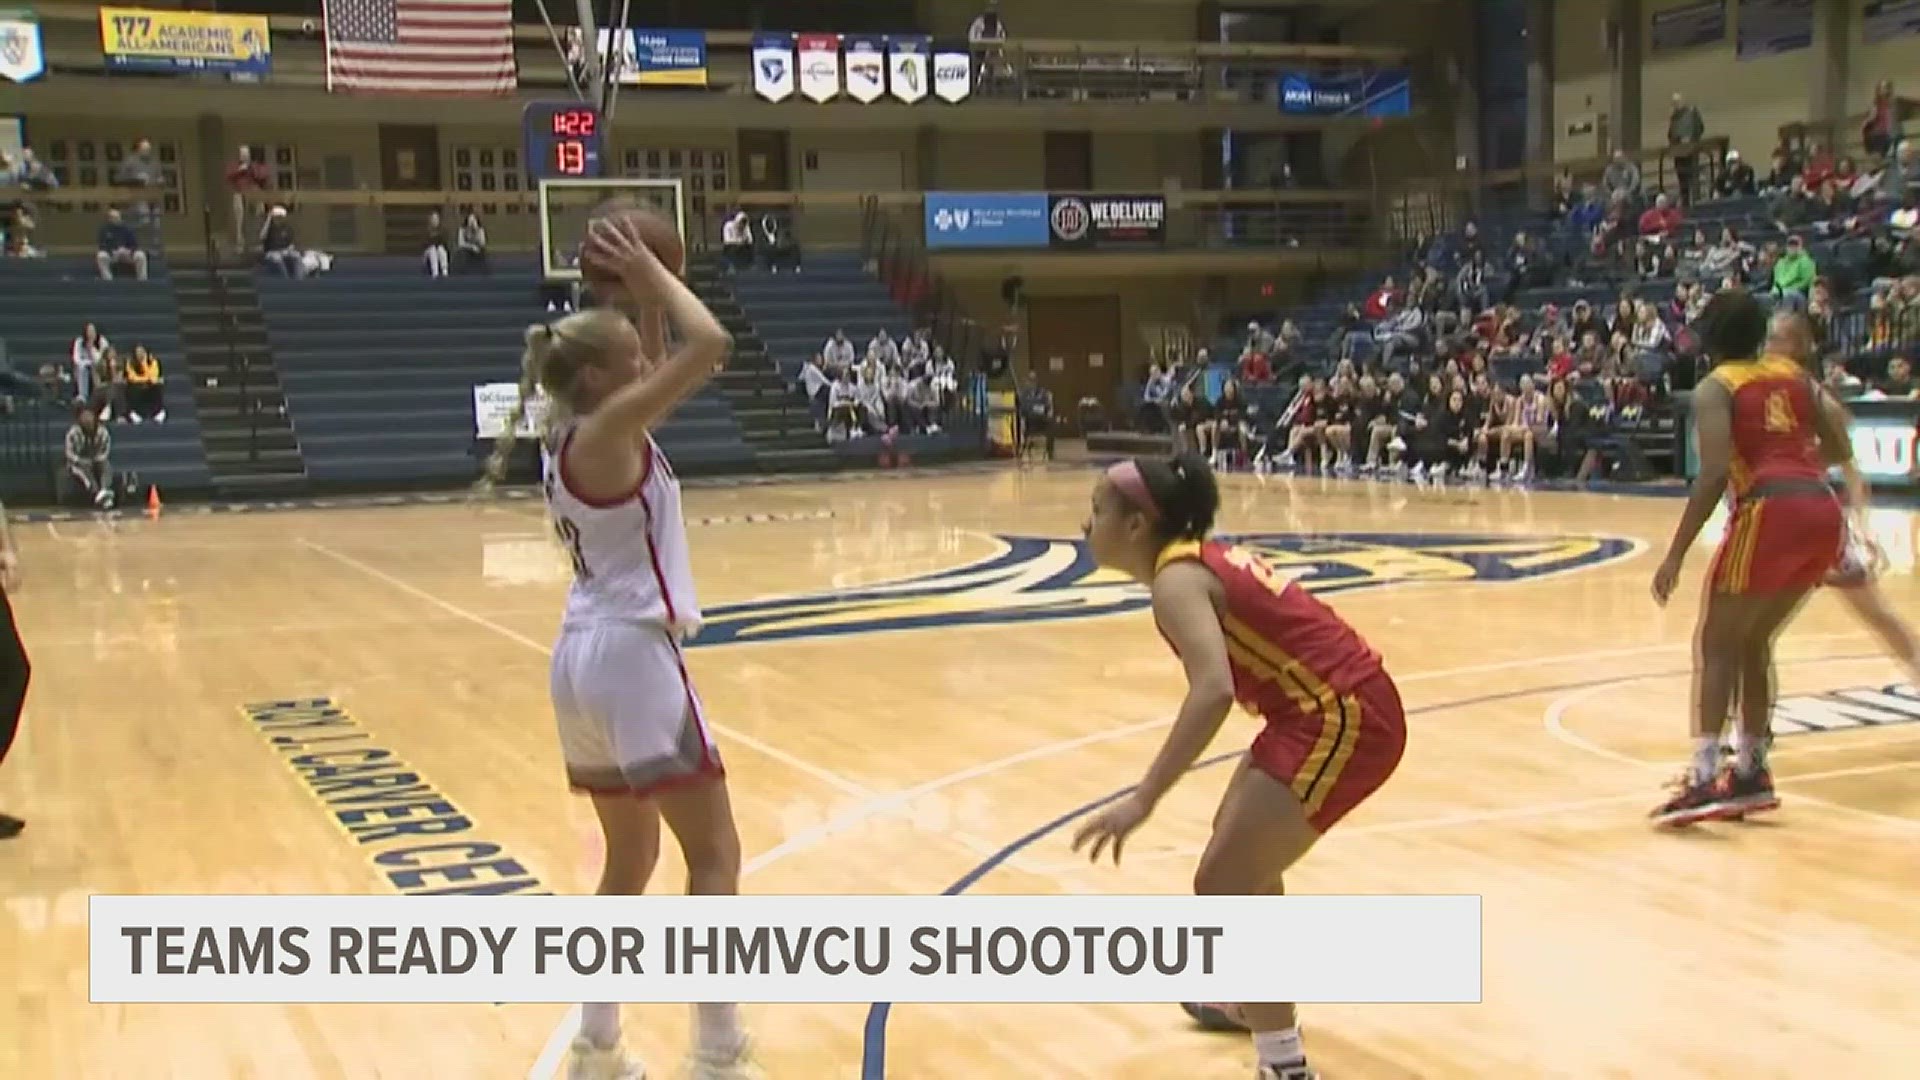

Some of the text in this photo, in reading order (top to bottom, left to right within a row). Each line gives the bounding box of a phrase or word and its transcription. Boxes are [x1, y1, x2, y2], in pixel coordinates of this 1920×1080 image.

[112, 15, 234, 40] 177 ACADEMIC
[116, 37, 235, 54] ALL-AMERICANS
[554, 111, 594, 135] 1:22
[557, 141, 584, 174] 13
[1090, 201, 1109, 221] WE
[1110, 201, 1164, 221] DELIVER!
[290, 748, 473, 844] CARVER
